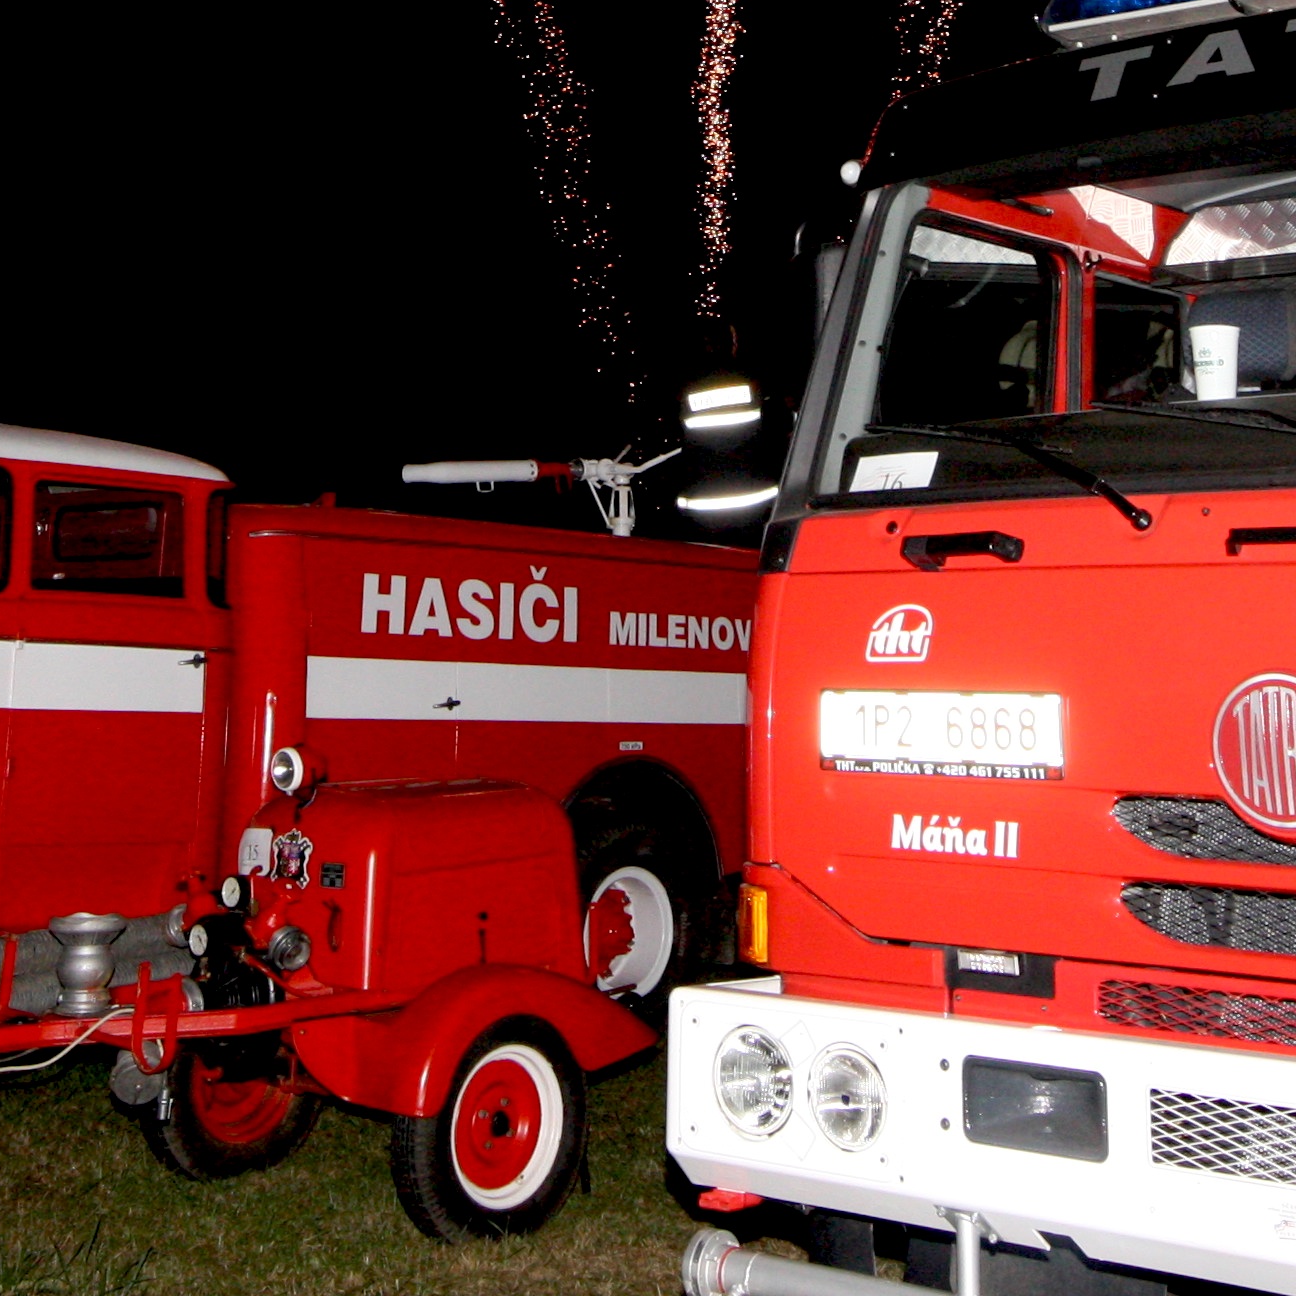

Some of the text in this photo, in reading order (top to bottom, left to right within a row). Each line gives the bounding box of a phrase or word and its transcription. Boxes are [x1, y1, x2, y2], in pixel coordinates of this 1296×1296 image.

[360, 565, 578, 643] HASIČI
[856, 704, 1037, 751] 1P2 6868
[835, 759, 856, 772] THT
[872, 760, 921, 775] POLIČKA
[936, 764, 967, 777] +420
[969, 765, 993, 778] 461
[995, 766, 1021, 779] 755
[1023, 768, 1045, 780] 111
[247, 844, 259, 861] 15
[890, 813, 988, 856] Máňa
